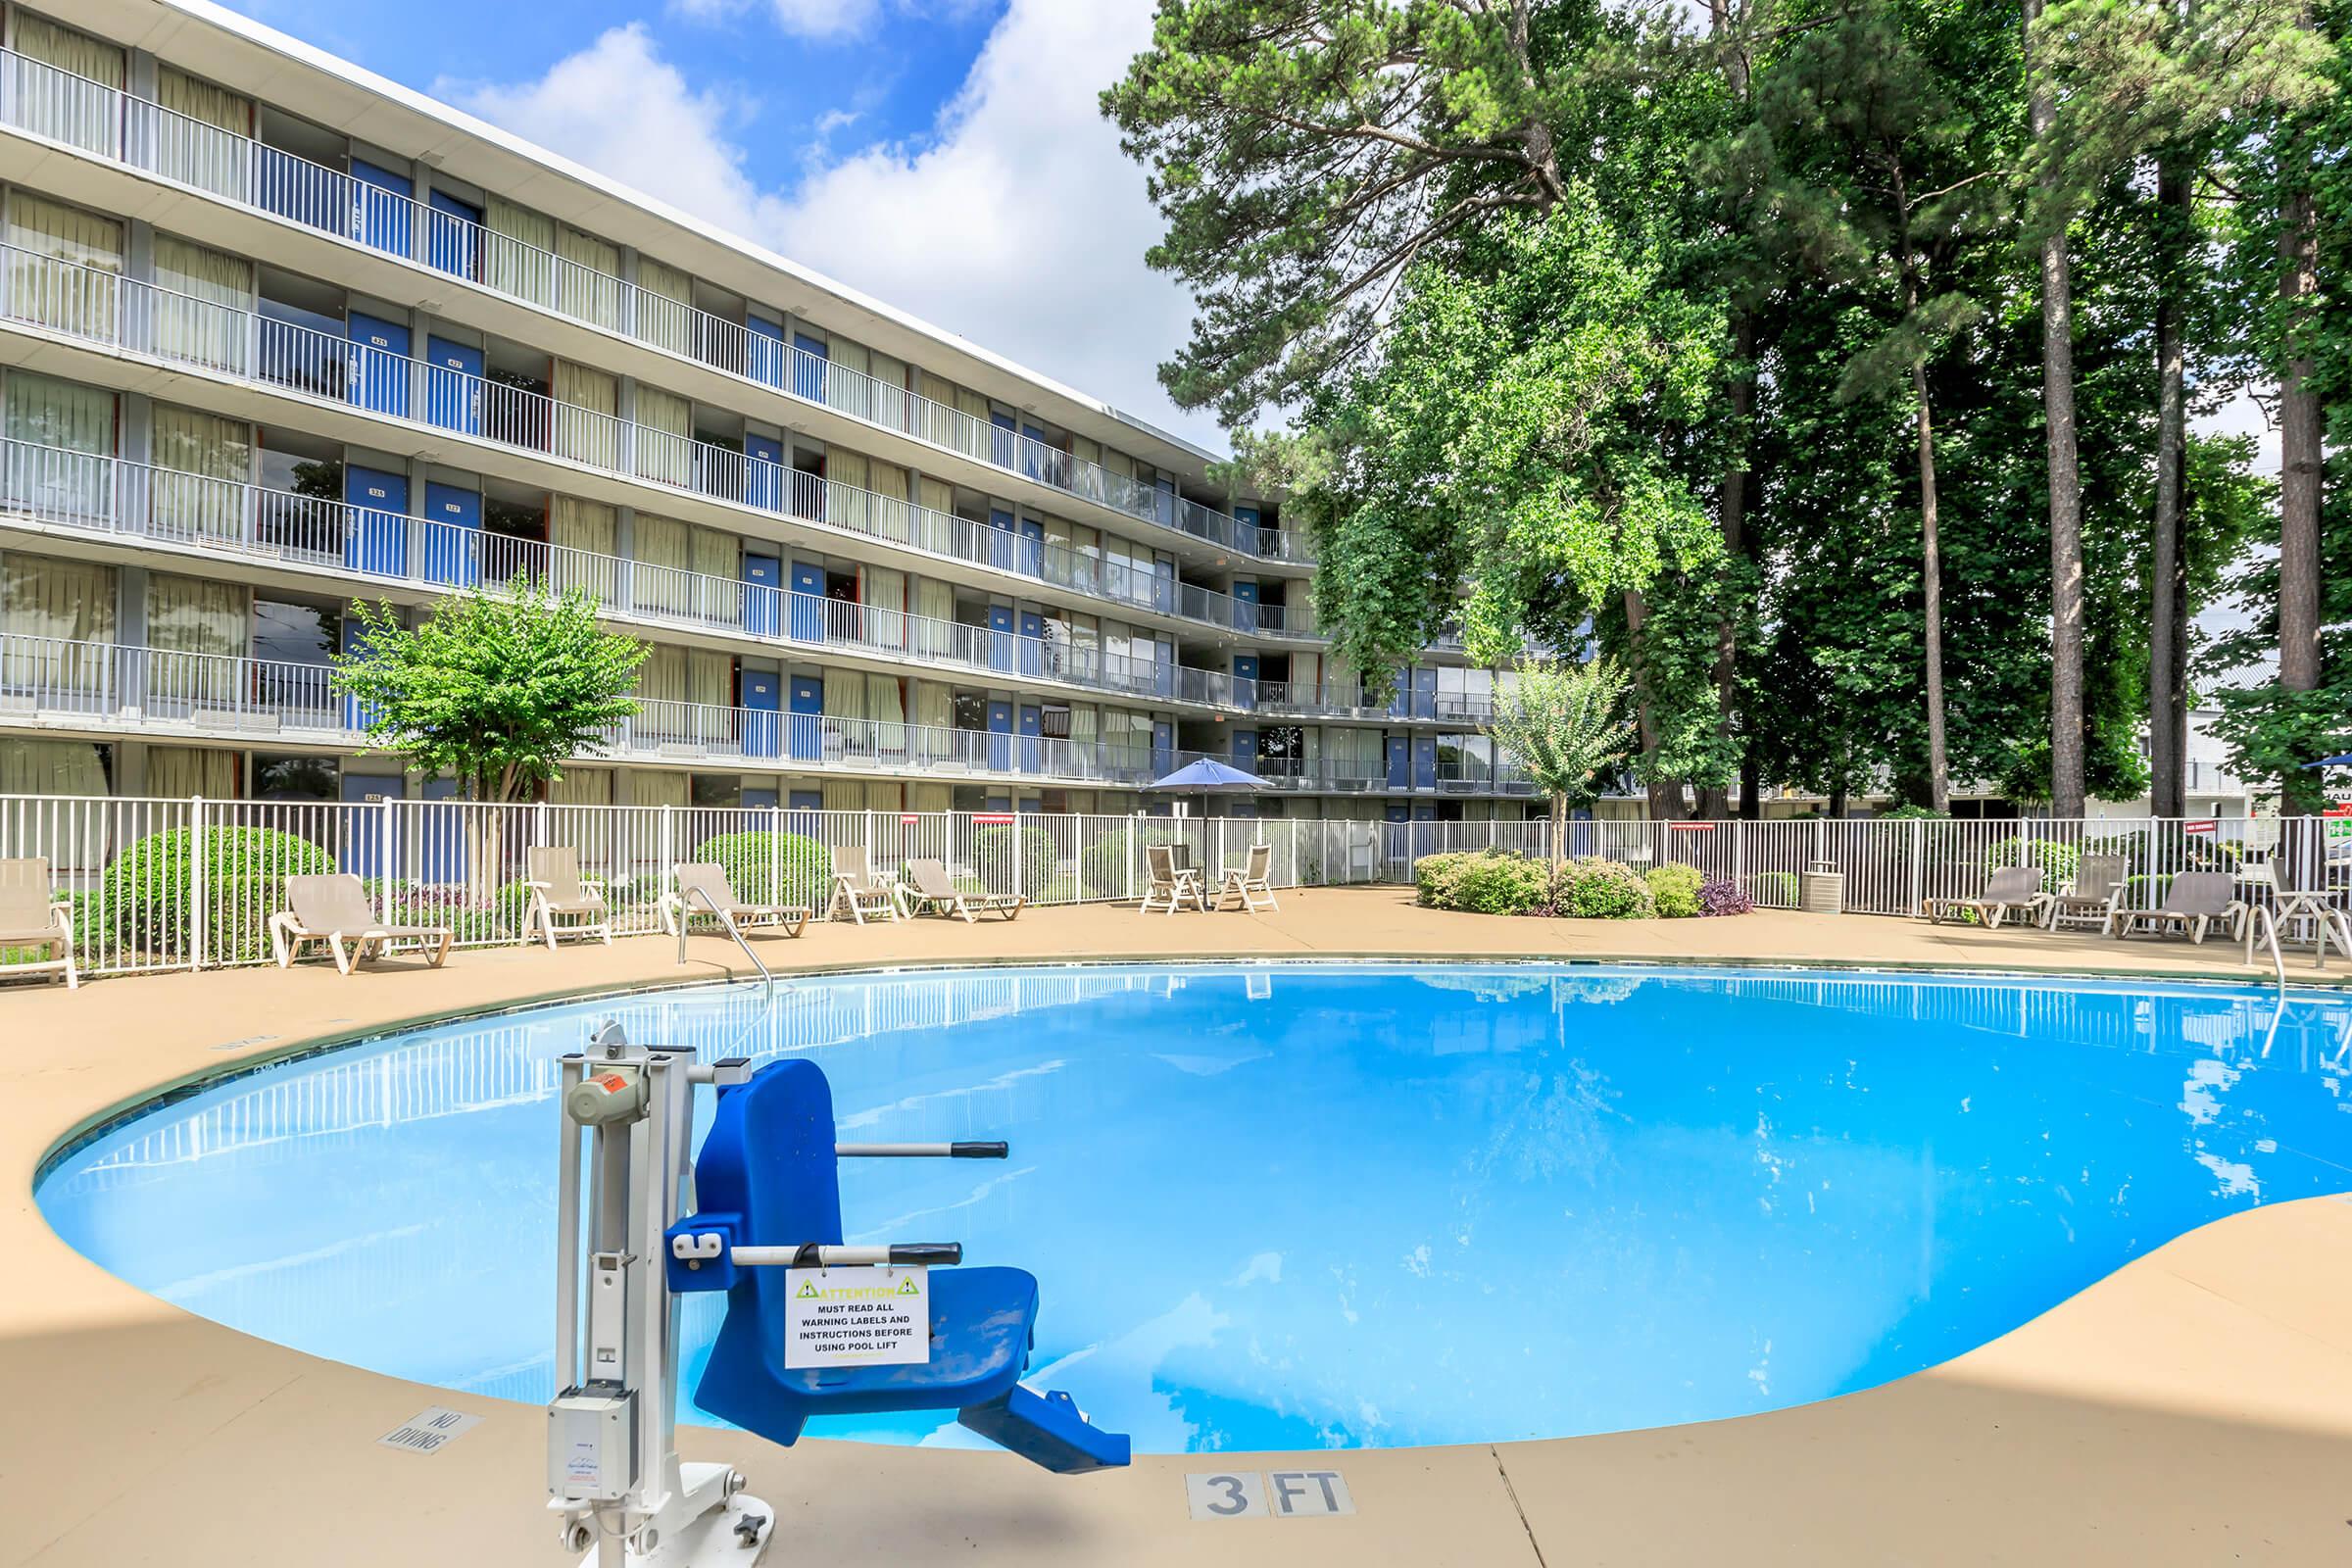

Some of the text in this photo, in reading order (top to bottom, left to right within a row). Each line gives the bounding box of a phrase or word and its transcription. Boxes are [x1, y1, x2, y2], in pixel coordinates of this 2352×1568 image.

[819, 1287, 895, 1300] ATTENTION
[802, 1318, 848, 1327] WARNING
[851, 1316, 887, 1325] LABELS
[800, 1328, 912, 1340] INSTRUCTIONS BEFORE
[815, 1344, 845, 1352] USING
[427, 1411, 462, 1429] NO
[387, 1428, 448, 1450] DIVING
[1206, 1472, 1339, 1515] 3 FT
